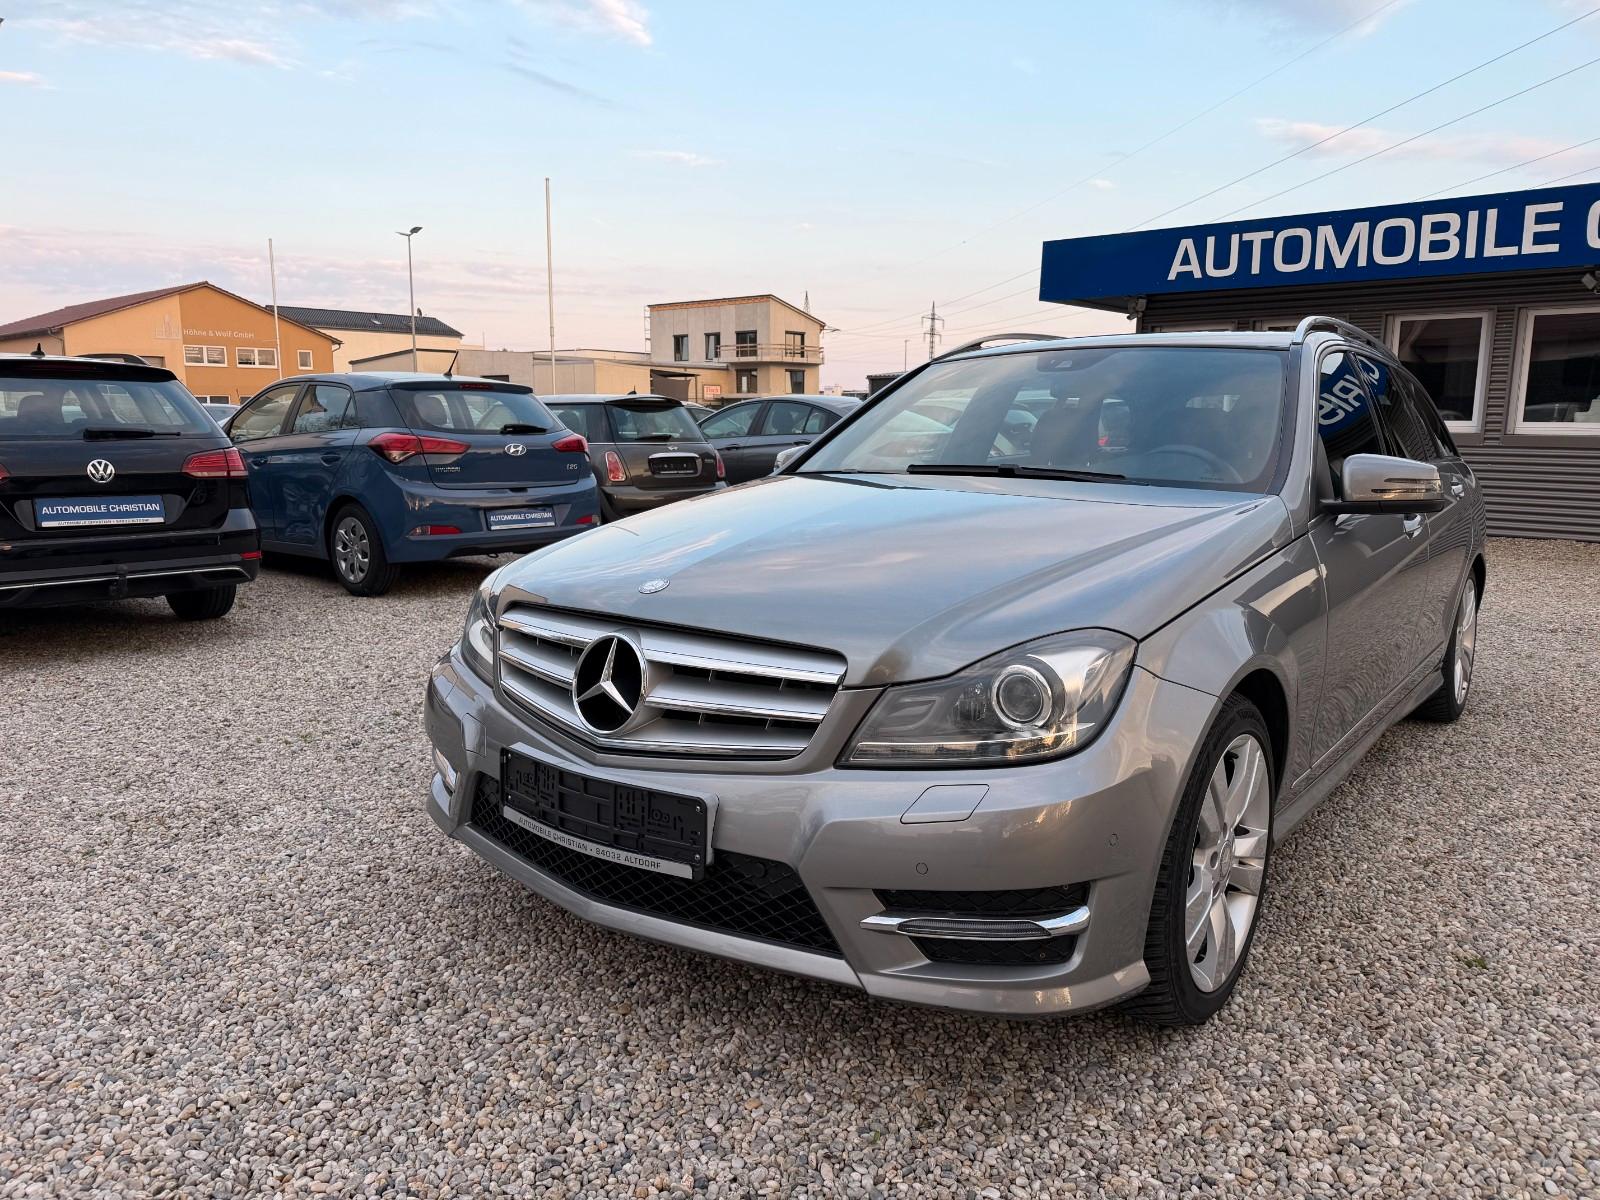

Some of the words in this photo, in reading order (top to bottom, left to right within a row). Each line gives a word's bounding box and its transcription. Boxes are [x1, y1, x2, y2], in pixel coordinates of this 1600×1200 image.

[1166, 201, 1564, 281] AUTOMOBILE
[183, 328, 207, 337] Höhne
[208, 329, 214, 337] &
[215, 330, 233, 338] Wolf
[233, 331, 255, 339] GmbH
[42, 504, 108, 515] AUTOMOBILE
[109, 503, 160, 513] CHRISTIAN
[490, 513, 526, 521] AUTOMOBILE
[525, 511, 553, 519] CHRISTIAN
[518, 816, 552, 838] AUTOMOBILE
[552, 832, 588, 852] CHRISTIAN
[595, 847, 622, 861] 84032
[624, 855, 661, 870] ALTDORF
